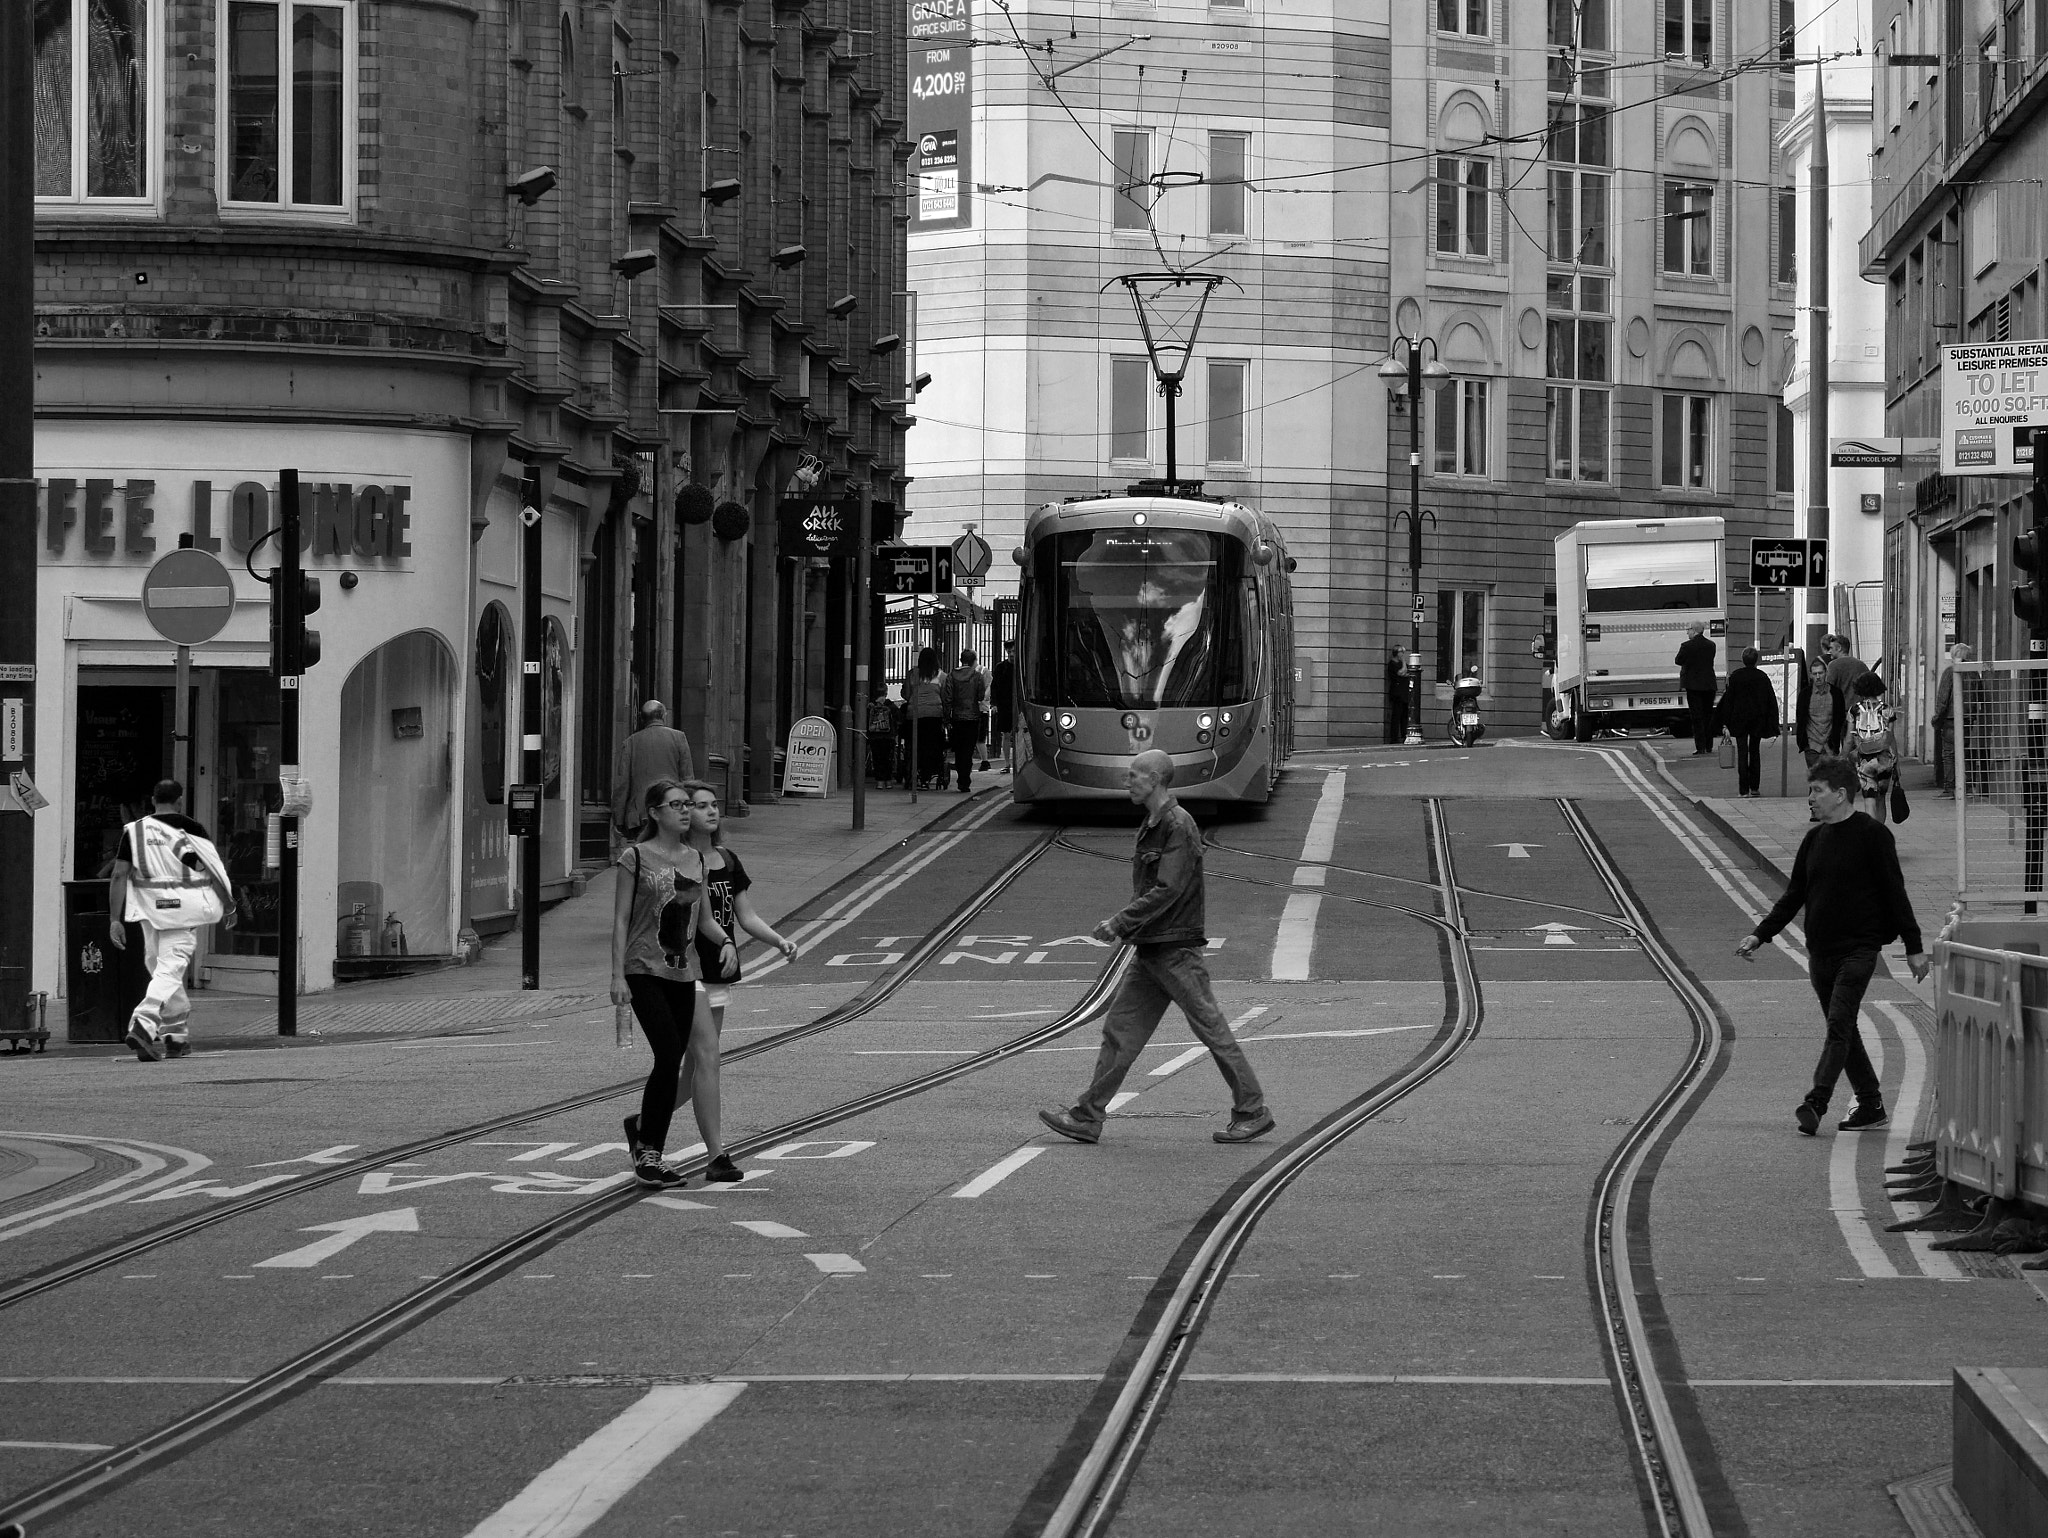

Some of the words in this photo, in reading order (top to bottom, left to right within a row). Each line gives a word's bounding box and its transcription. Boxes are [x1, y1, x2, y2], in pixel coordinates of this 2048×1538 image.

[912, 0, 954, 20] GRADE
[956, 0, 966, 15] A
[912, 22, 939, 37] OFFICE
[939, 18, 967, 33] SUITES
[926, 49, 950, 64] FROM
[912, 72, 953, 101] 4,200
[954, 71, 966, 83] SQ
[954, 83, 965, 95] FT
[923, 141, 936, 151] GVA
[1950, 349, 2016, 360] SUBSTANTIAL
[2018, 344, 2048, 356] RETAIL
[1957, 359, 1997, 371] LEISURE
[1998, 356, 2048, 369] PREMISES
[1967, 373, 1995, 396] TO
[2000, 370, 2039, 394] LET
[1956, 398, 2000, 417] 16,000
[1975, 417, 1988, 425] ALL
[1989, 415, 2029, 424] ENQUIRIES
[1958, 452, 1971, 460] 0121
[1970, 451, 1980, 460] 232
[2016, 448, 2029, 459] 0121
[809, 505, 839, 518] ALL
[193, 480, 412, 557] LOUNGE
[802, 517, 844, 530] GREEK
[1415, 596, 1424, 609] P
[2031, 641, 2045, 650] 13
[525, 663, 537, 671] 11
[282, 677, 296, 687] 10
[800, 724, 825, 737] OPEN
[792, 741, 827, 757] ikon
[707, 881, 733, 897] HITE
